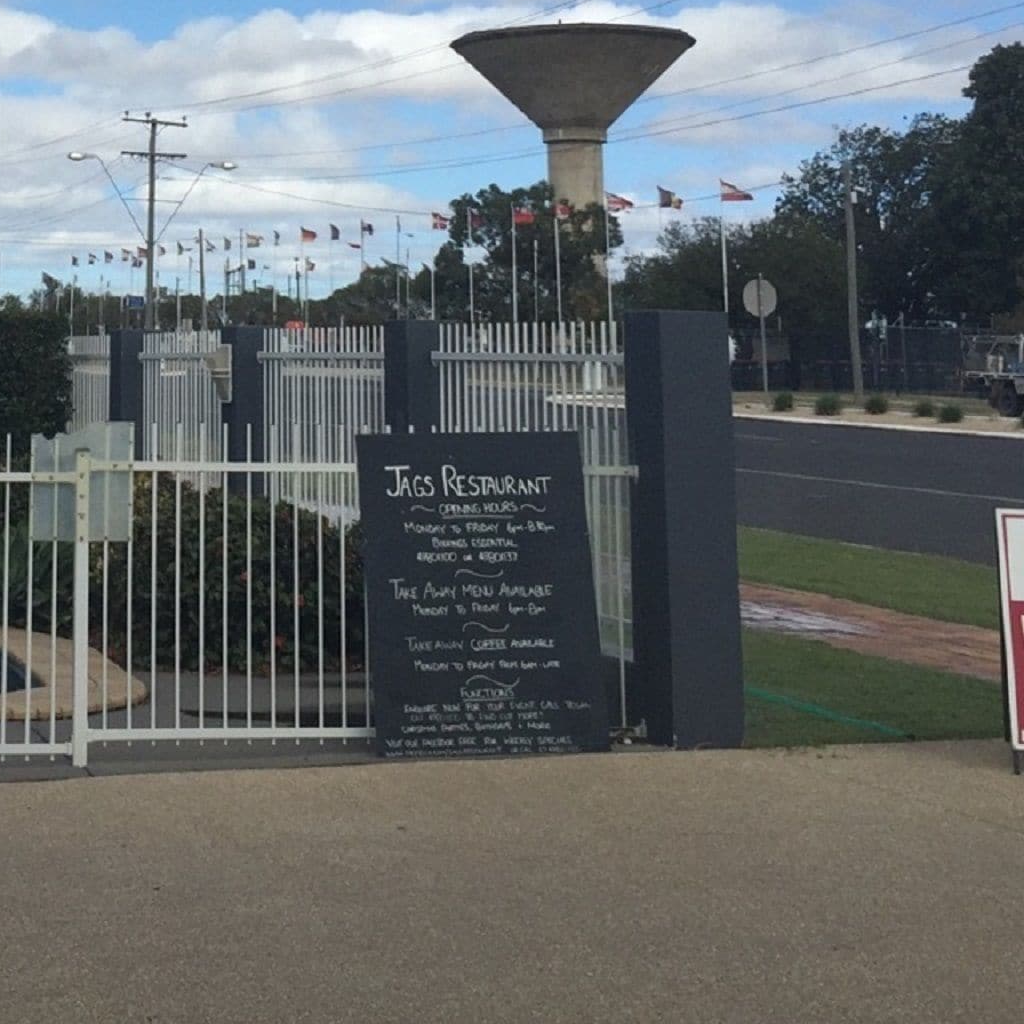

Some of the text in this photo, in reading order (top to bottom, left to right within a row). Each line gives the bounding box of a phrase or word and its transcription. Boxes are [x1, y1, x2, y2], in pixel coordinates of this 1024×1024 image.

[384, 465, 552, 497] JAGS RESTAURANT
[483, 501, 518, 513] HOURS
[404, 522, 446, 534] MONDAY
[465, 522, 499, 533] FRIDAY
[389, 578, 554, 600] TAKE AWAY MENU AVAILABLE
[460, 687, 515, 699] FUNCTIONS
